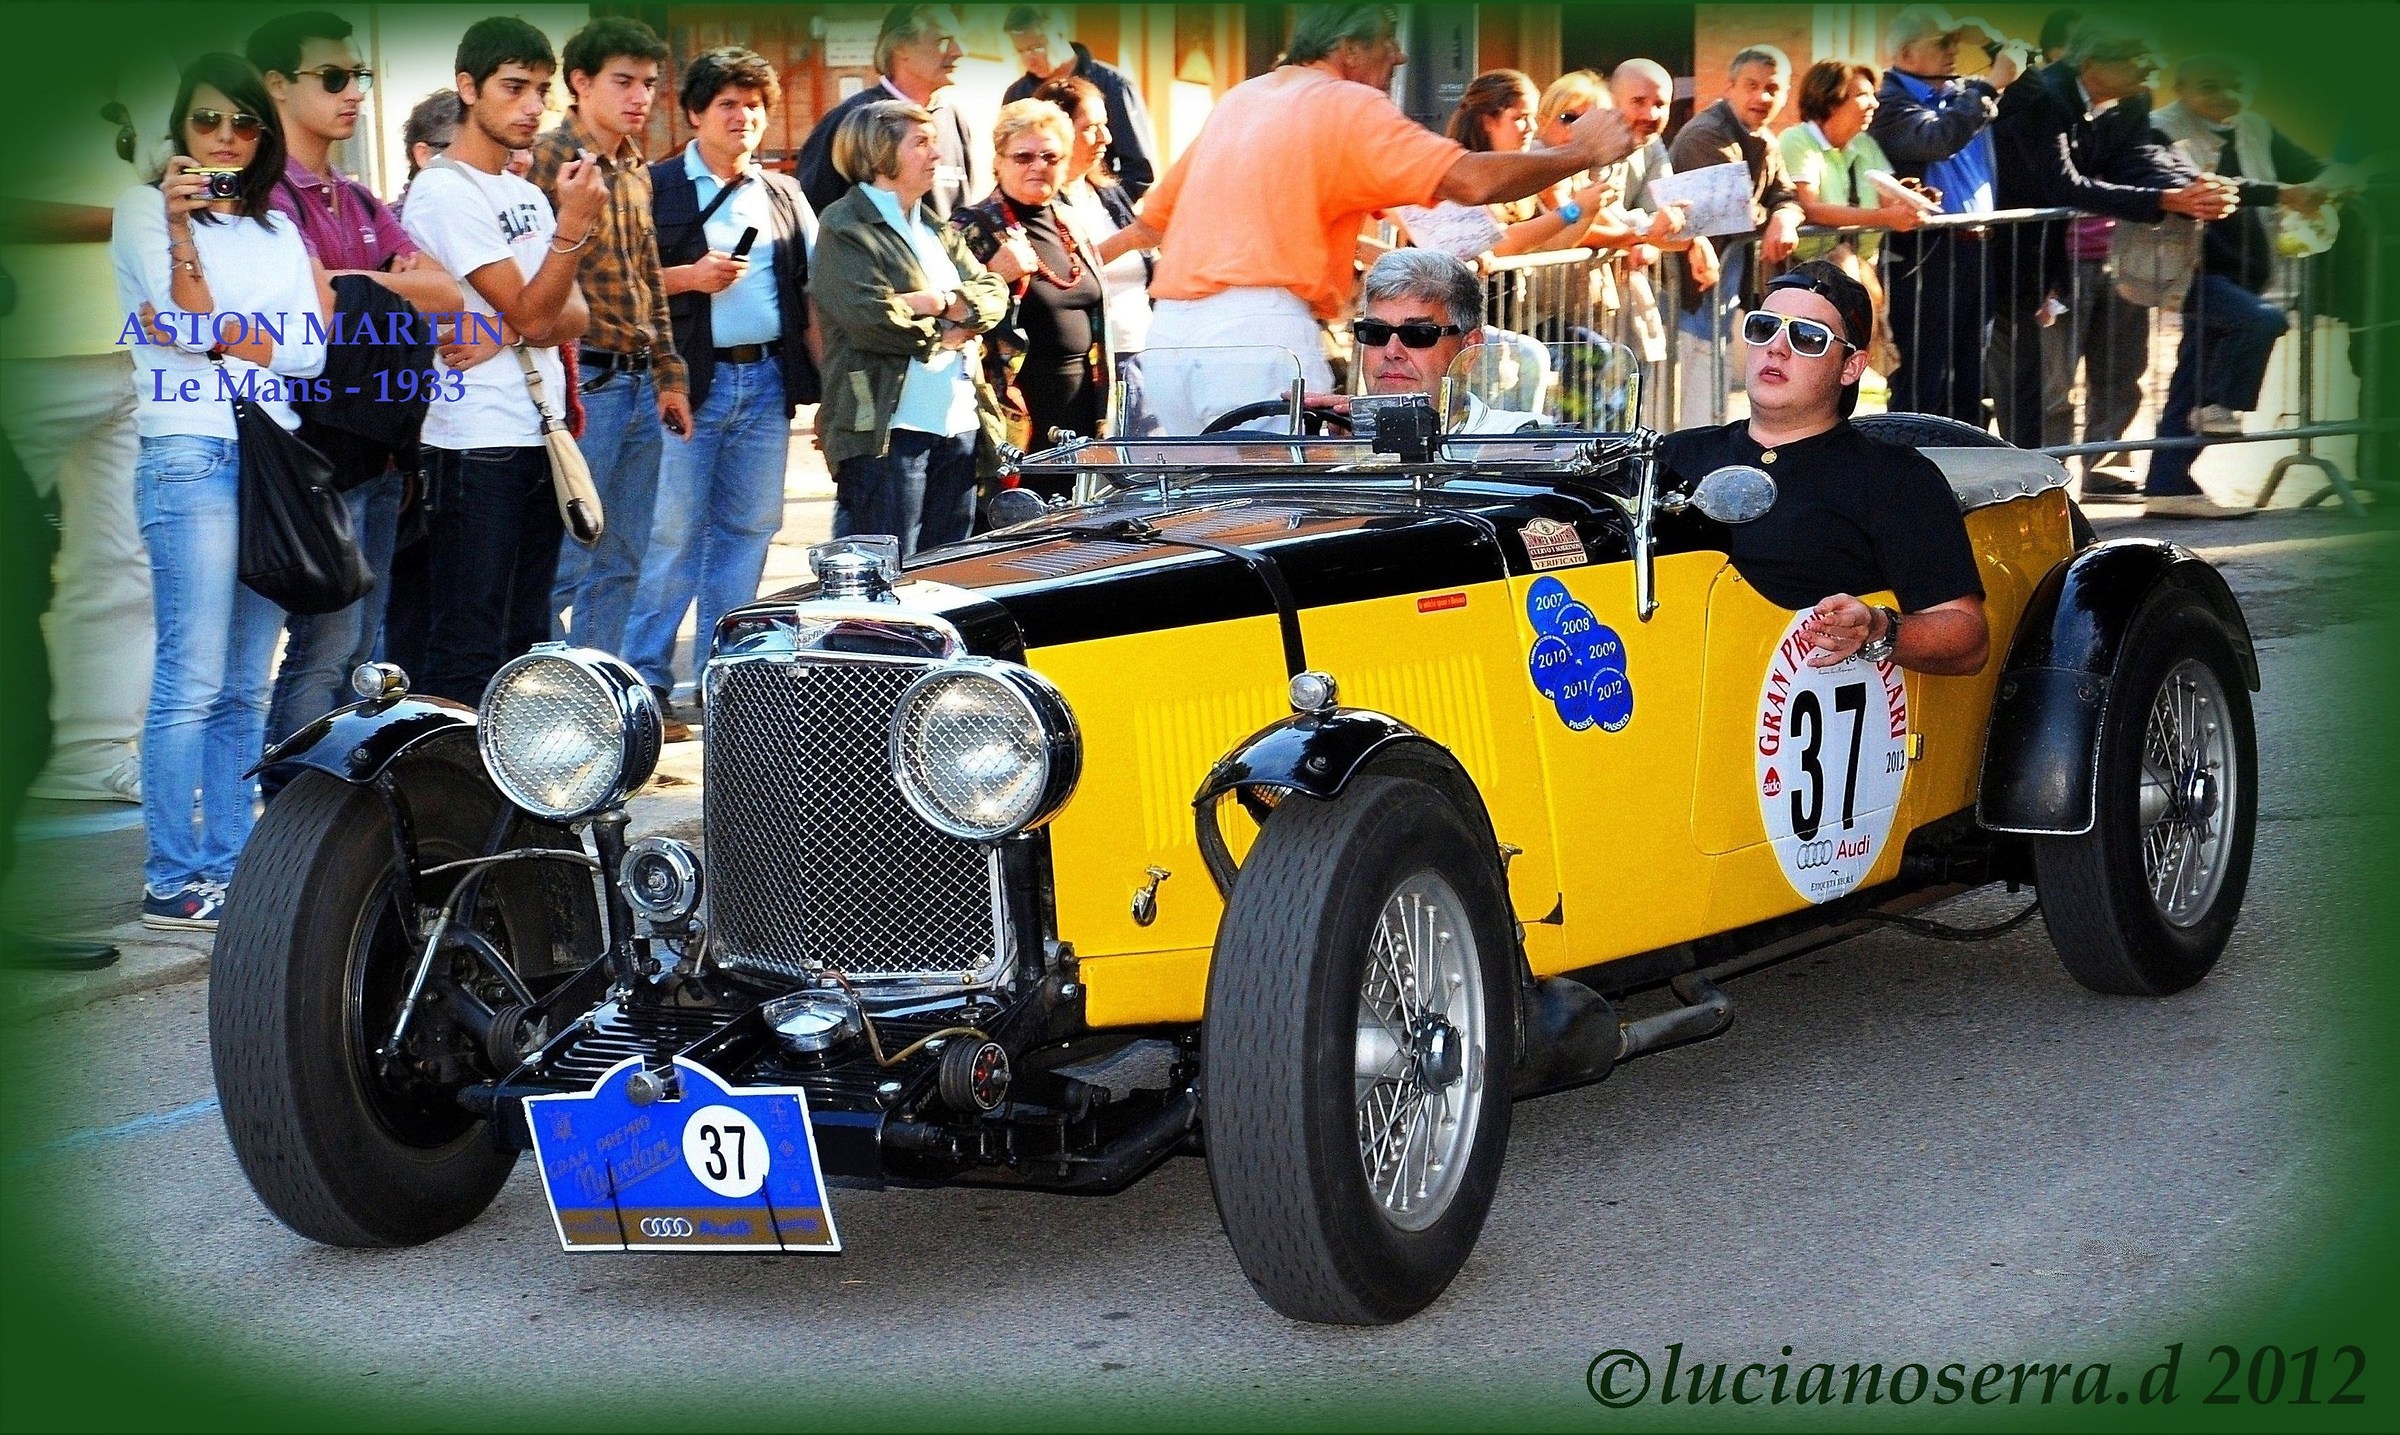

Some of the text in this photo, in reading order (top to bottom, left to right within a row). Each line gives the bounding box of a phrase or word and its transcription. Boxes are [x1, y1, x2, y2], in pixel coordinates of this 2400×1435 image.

[1534, 555, 1585, 569] VERIFICATO
[1536, 592, 1564, 611] 2007
[1562, 617, 1590, 635] 2008
[1538, 649, 1567, 669] 2010
[1589, 641, 1617, 660] 2009
[1563, 679, 1588, 699] 2011
[1597, 680, 1622, 701] 2012
[1603, 713, 1630, 731] PASSED
[1758, 668, 1791, 756] GRAN
[1790, 682, 1867, 842] 37
[1885, 750, 1905, 774] 2012
[1763, 778, 1782, 793] aido
[1836, 834, 1871, 860] Audi
[699, 1125, 746, 1181] 37
